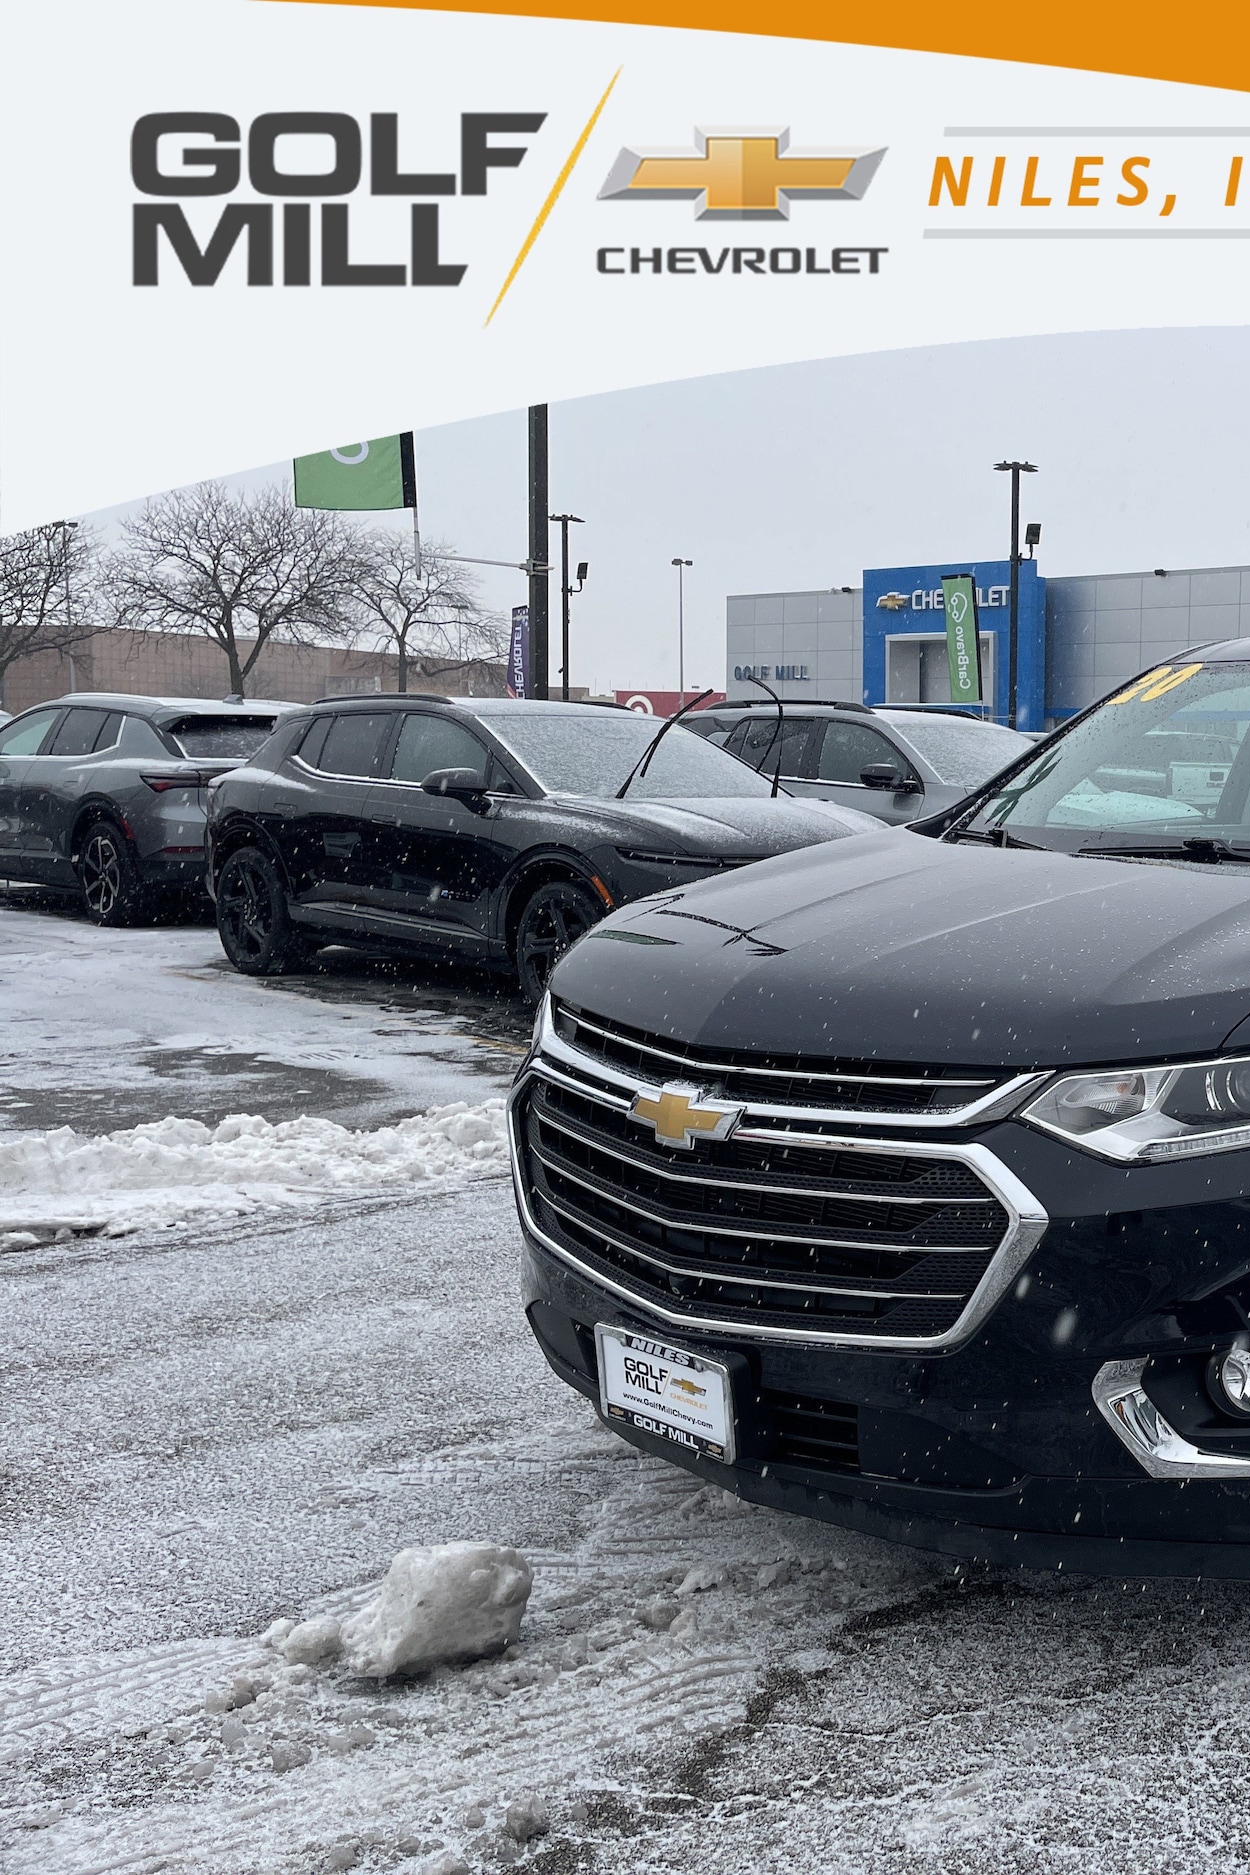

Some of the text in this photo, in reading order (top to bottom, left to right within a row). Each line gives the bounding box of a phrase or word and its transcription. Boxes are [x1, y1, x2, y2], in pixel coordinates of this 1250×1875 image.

[911, 585, 1011, 610] CHELET
[734, 665, 809, 681] GOLF MILL
[1104, 663, 1204, 704] 20
[631, 1337, 690, 1366] NILES
[624, 1357, 668, 1381] GOLF
[625, 1372, 662, 1395] MILL
[623, 1392, 714, 1430] www.GolfMillChevy.com
[633, 1414, 699, 1450] GOLF MILL
